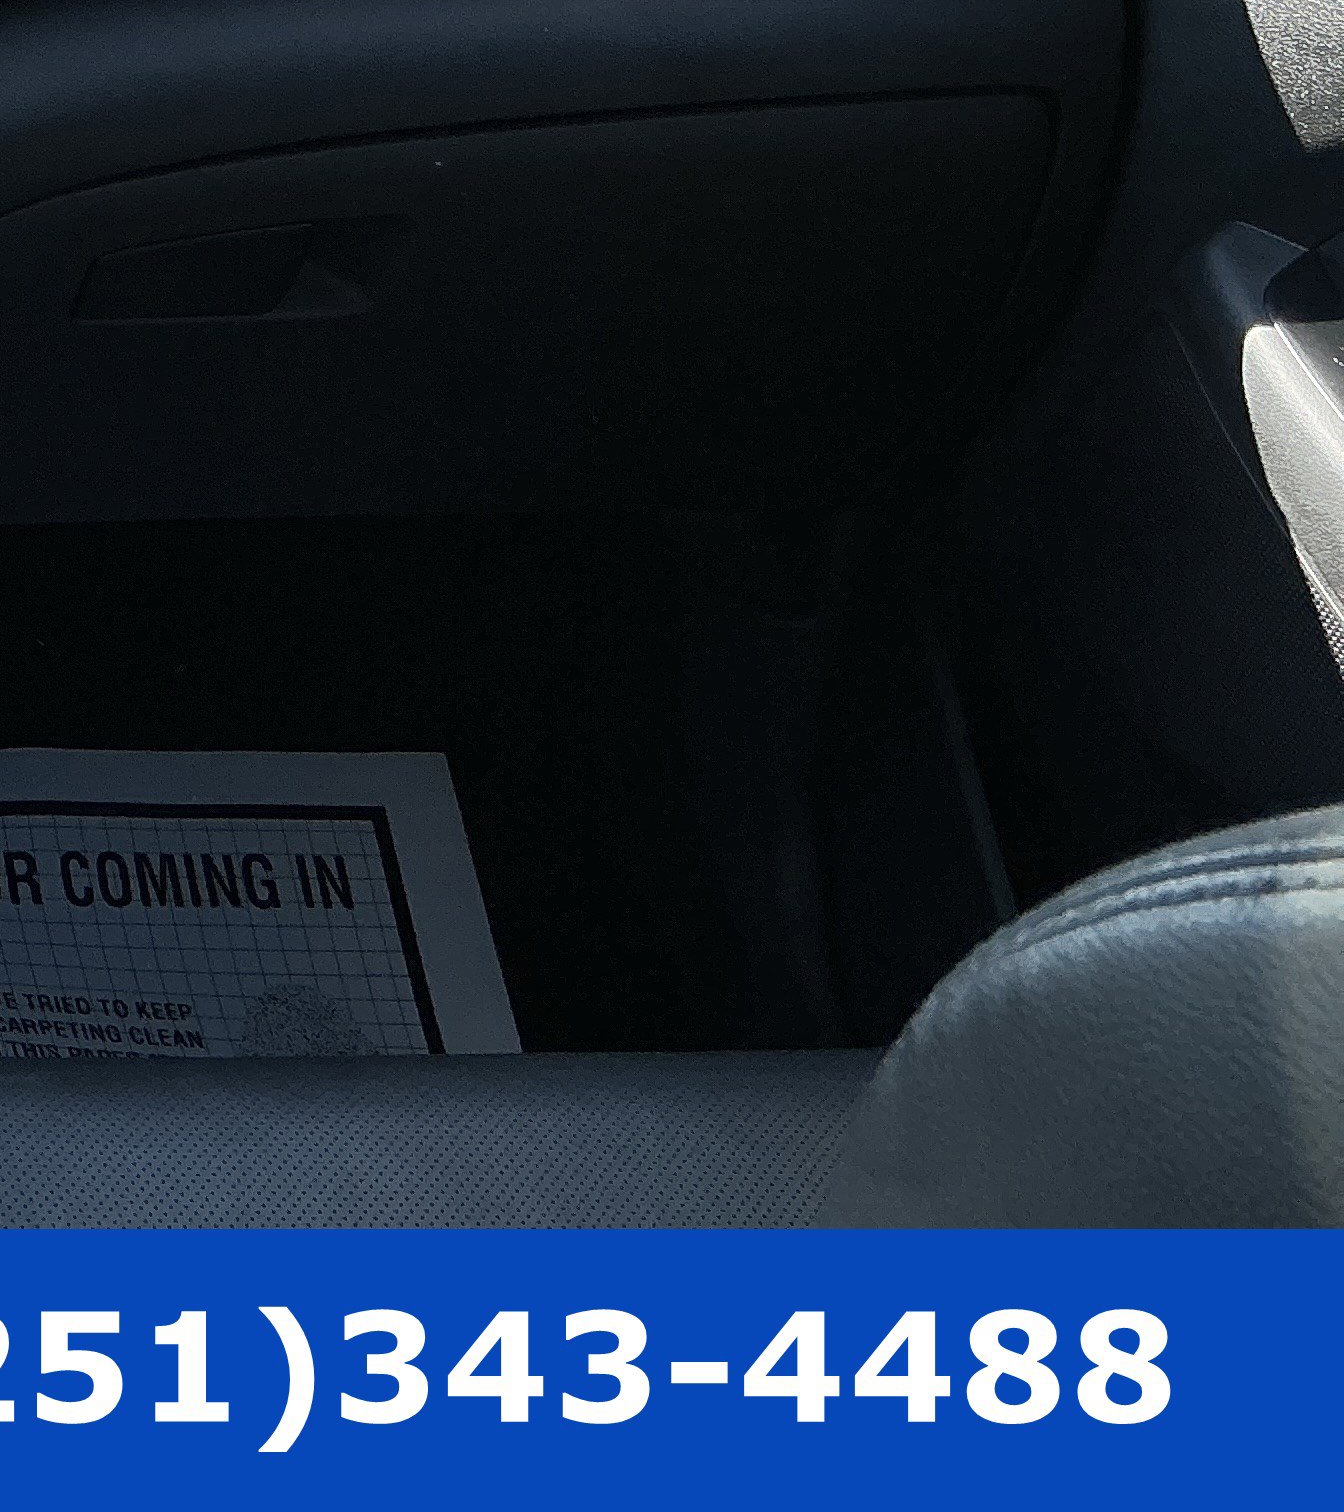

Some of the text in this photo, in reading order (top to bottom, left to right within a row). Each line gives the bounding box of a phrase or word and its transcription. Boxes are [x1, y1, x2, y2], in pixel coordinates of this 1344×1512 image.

[62, 850, 282, 910] COMING
[295, 853, 355, 910] IN
[22, 992, 91, 1015] TRIED
[97, 997, 130, 1019] TO
[134, 1000, 193, 1022] KEEP
[6, 1039, 61, 1059] THIS
[128, 1025, 209, 1050] CLEAN
